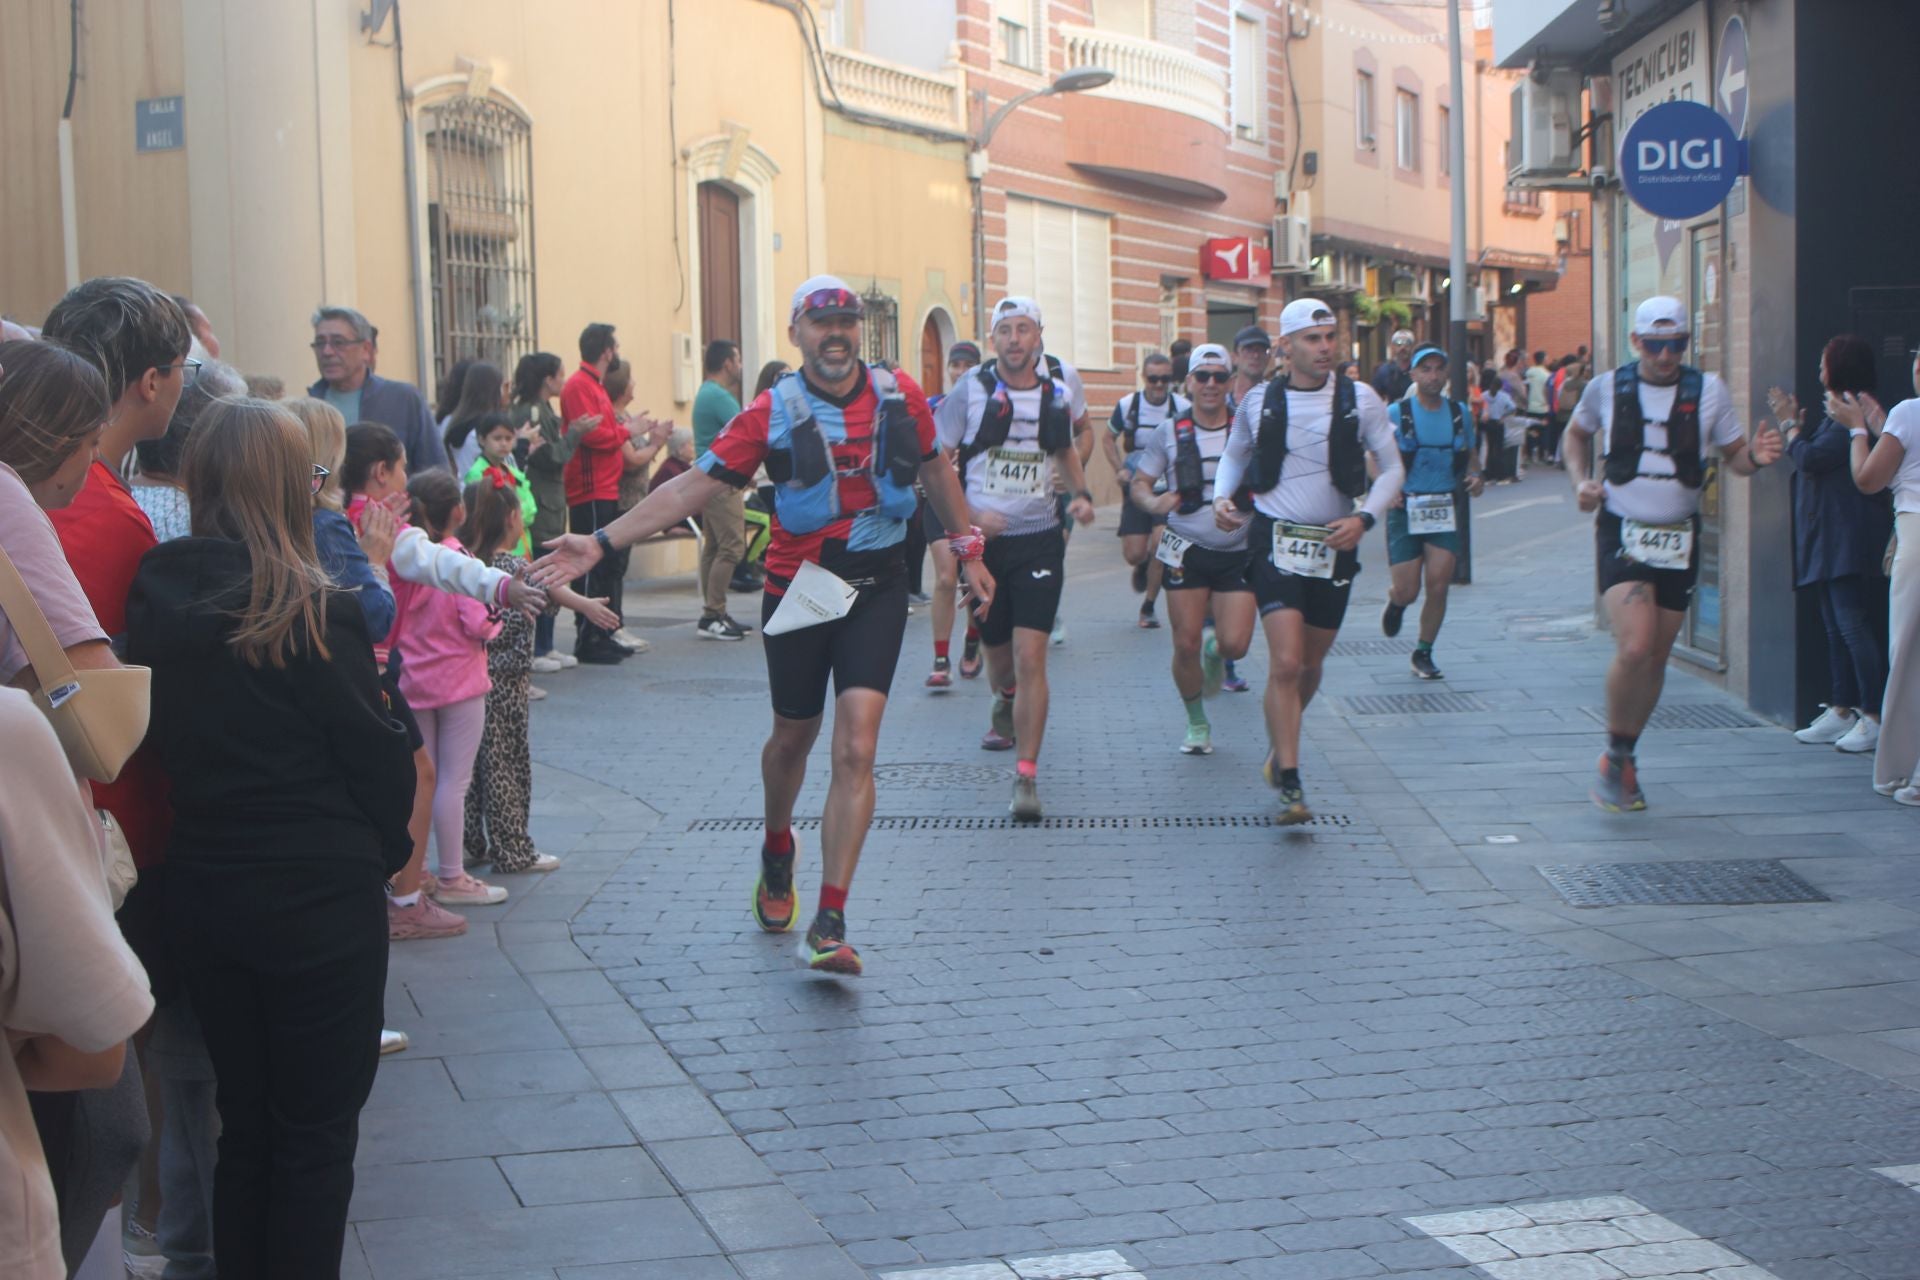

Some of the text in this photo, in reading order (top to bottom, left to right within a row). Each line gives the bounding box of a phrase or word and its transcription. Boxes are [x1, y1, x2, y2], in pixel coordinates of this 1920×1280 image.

[1618, 29, 1695, 100] TECNICUBI
[1638, 139, 1722, 171] DIGI
[1000, 463, 1037, 481] 4471
[1420, 508, 1448, 521] 3453
[1287, 540, 1327, 560] 4474
[1640, 530, 1681, 551] 4473
